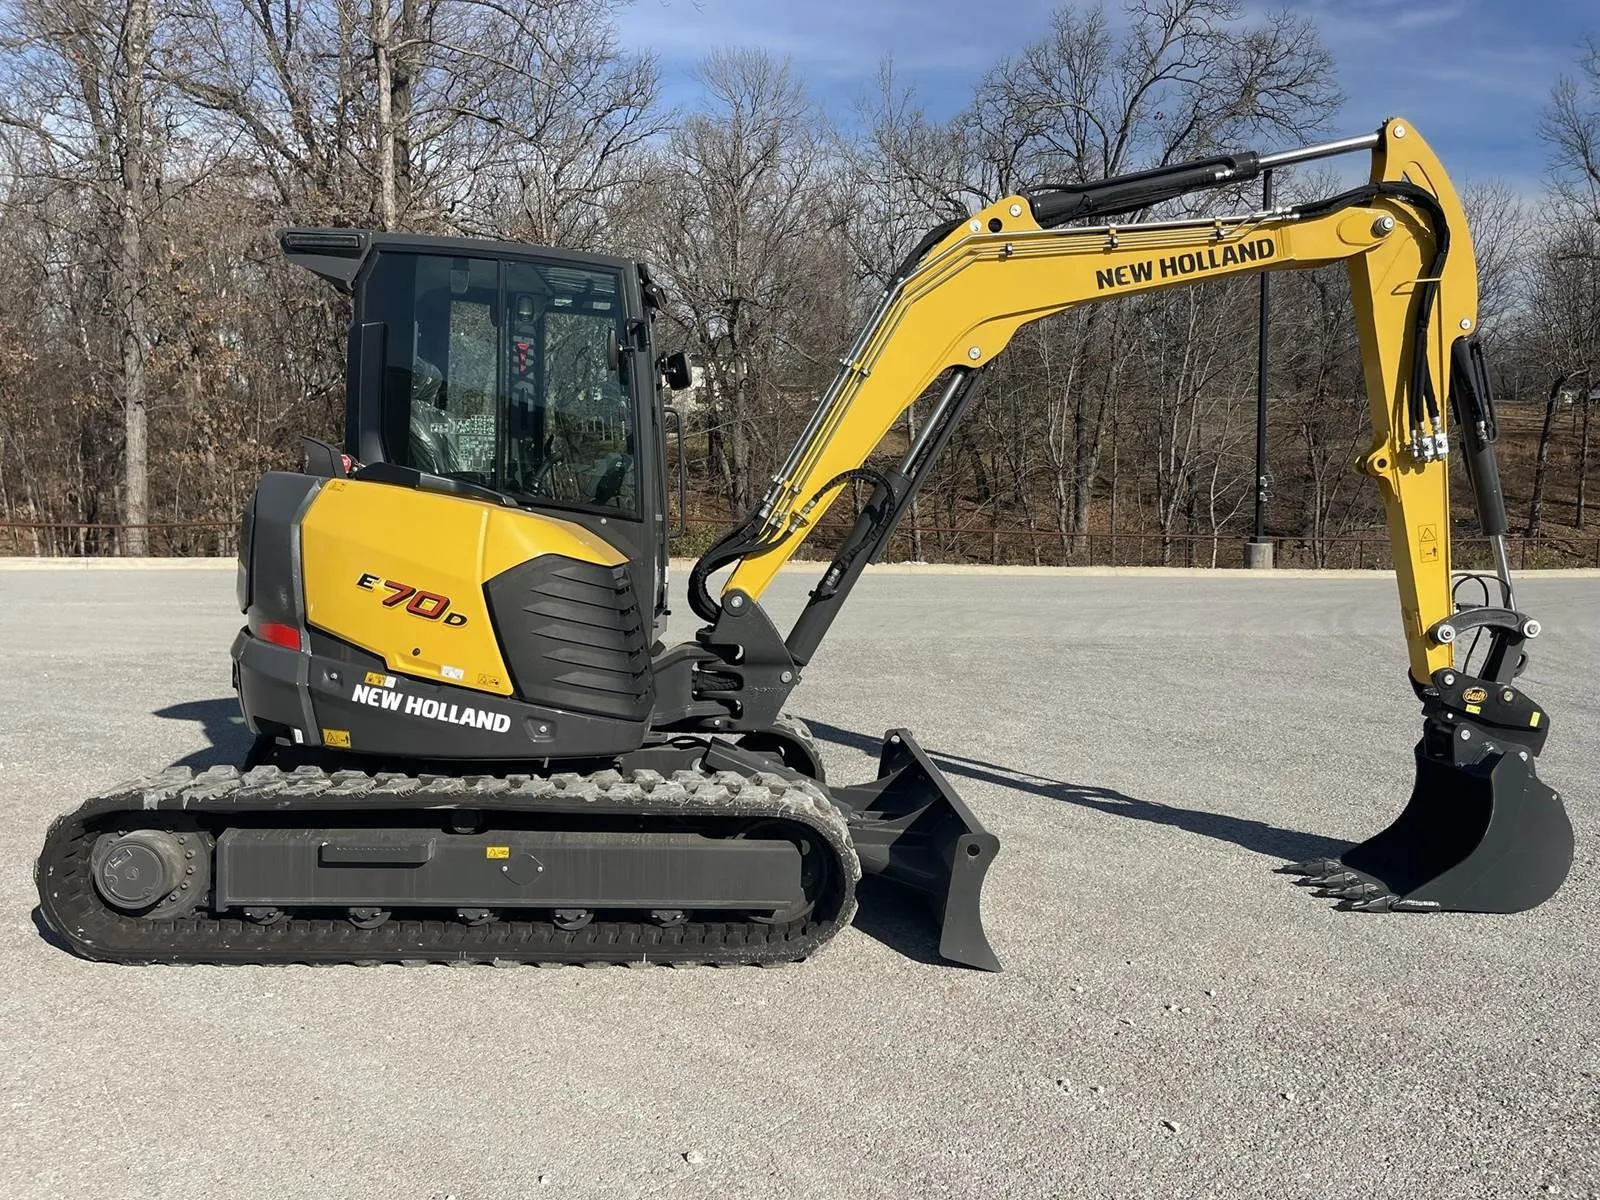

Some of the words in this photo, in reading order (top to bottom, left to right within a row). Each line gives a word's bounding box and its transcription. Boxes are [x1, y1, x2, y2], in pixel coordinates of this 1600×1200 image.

[1096, 261, 1153, 290] NEW
[1159, 238, 1275, 278] HOLLAND
[352, 684, 404, 711] NEW
[405, 695, 511, 733] HOLLAND
